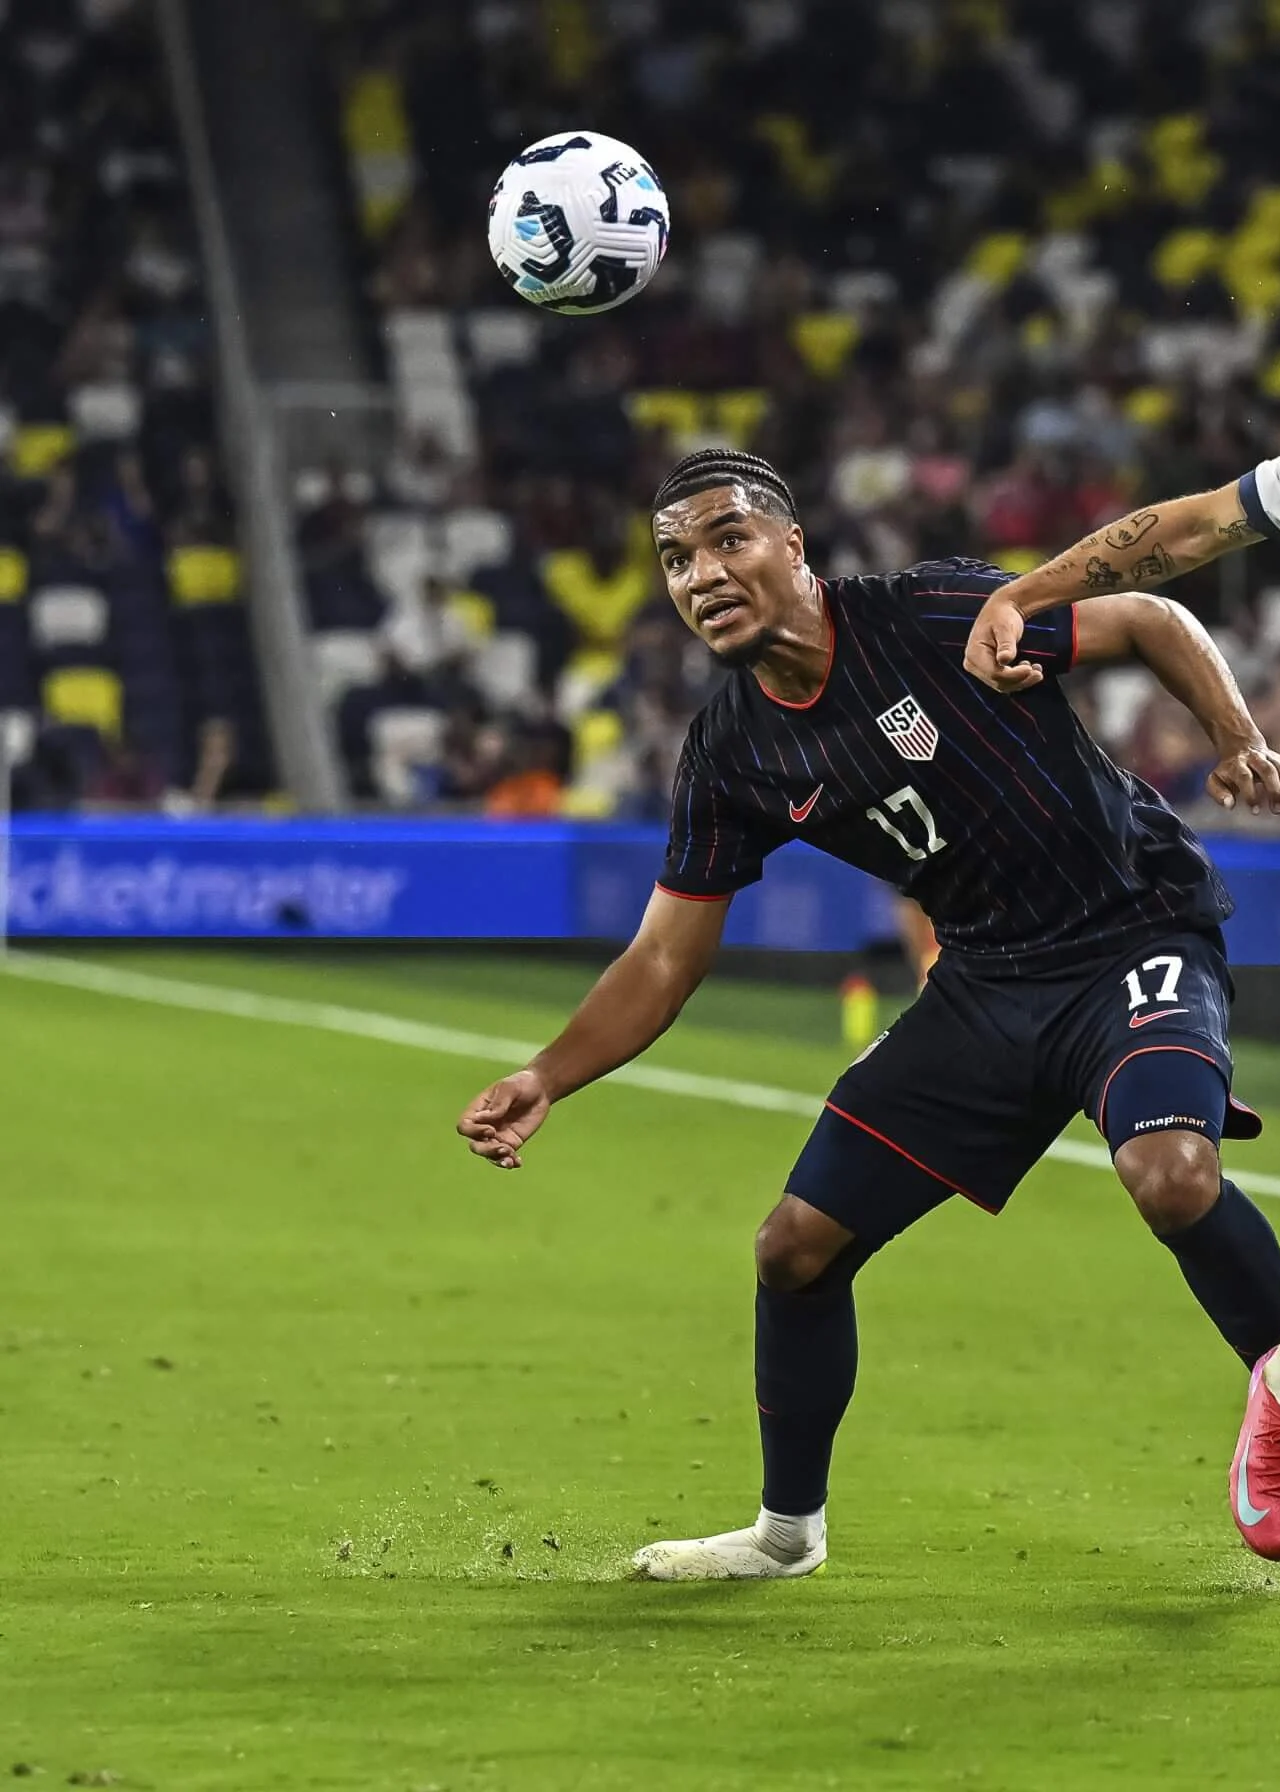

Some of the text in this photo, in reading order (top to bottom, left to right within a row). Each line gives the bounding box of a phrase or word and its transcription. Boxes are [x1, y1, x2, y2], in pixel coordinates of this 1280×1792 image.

[880, 700, 918, 734] USA
[866, 785, 948, 861] 17
[1120, 956, 1183, 1011] 17
